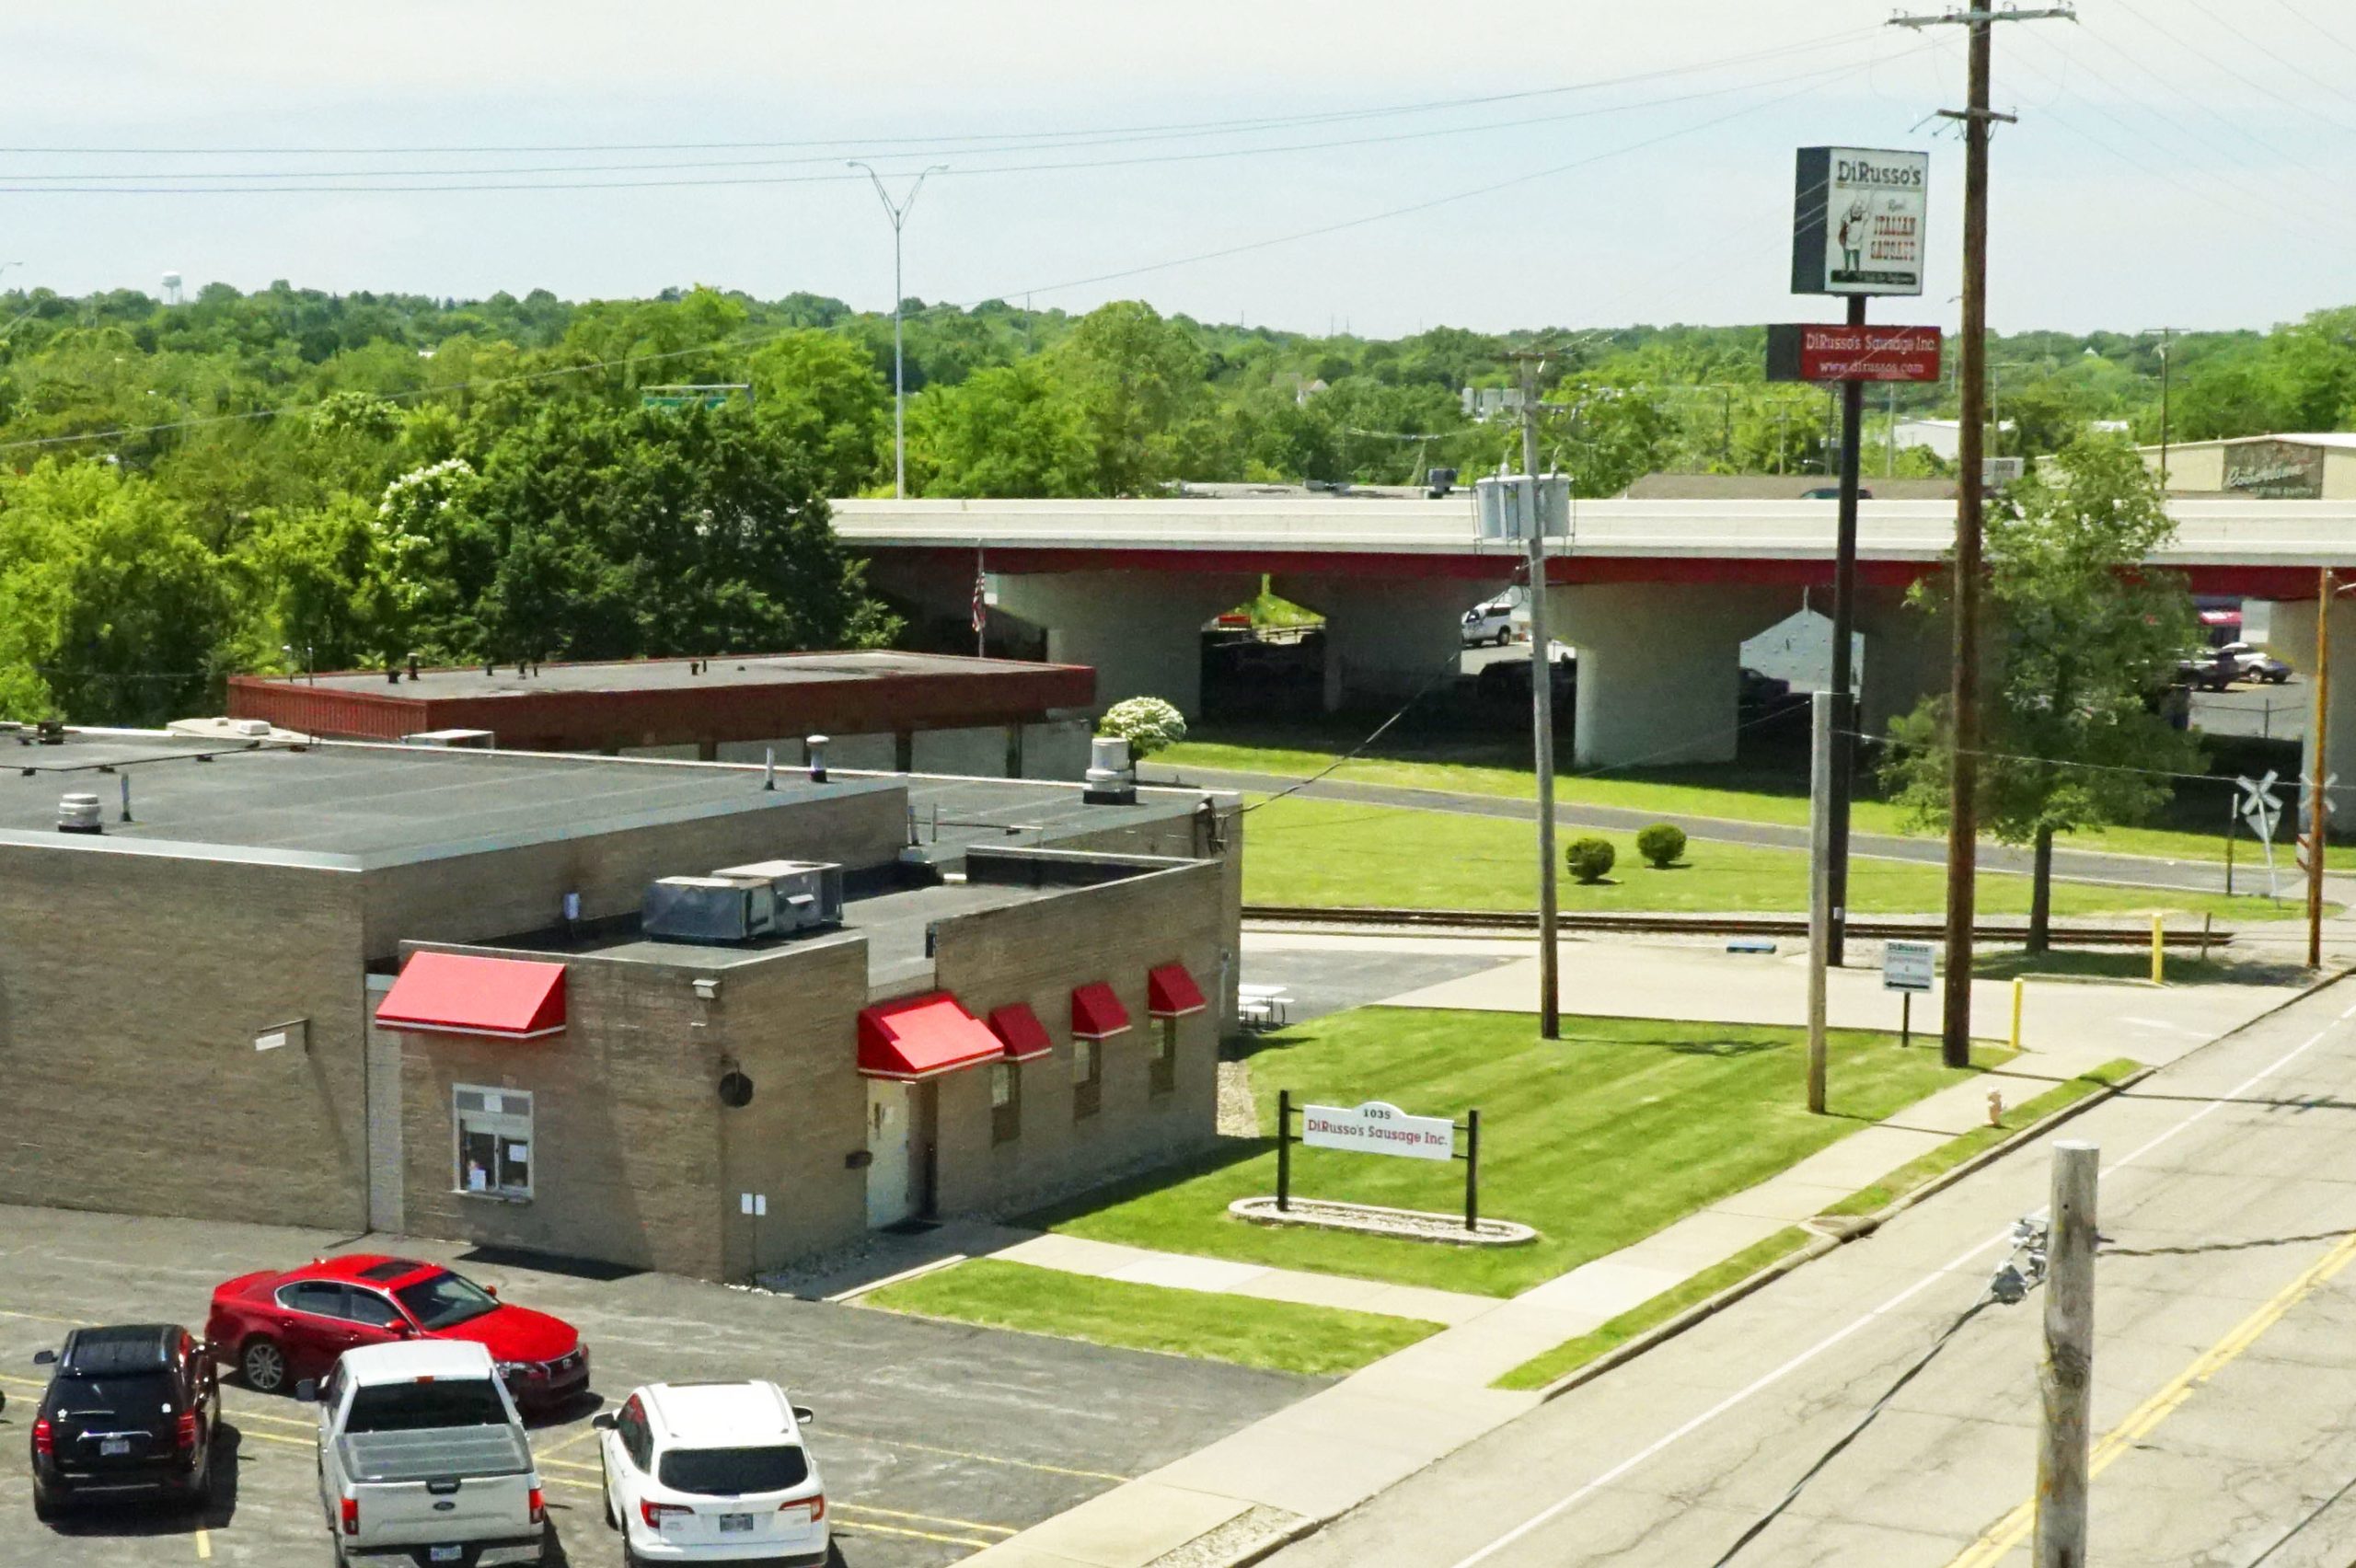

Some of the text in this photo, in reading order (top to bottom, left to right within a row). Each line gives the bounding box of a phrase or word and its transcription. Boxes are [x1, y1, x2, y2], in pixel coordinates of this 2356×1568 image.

[1837, 159, 1921, 186] DiRusso's
[1806, 332, 1861, 351] DiRusso's
[1865, 334, 1914, 355] Sausage
[1363, 1108, 1392, 1120] 1035
[1308, 1118, 1449, 1146] DiRusso's Sausage Inc.
